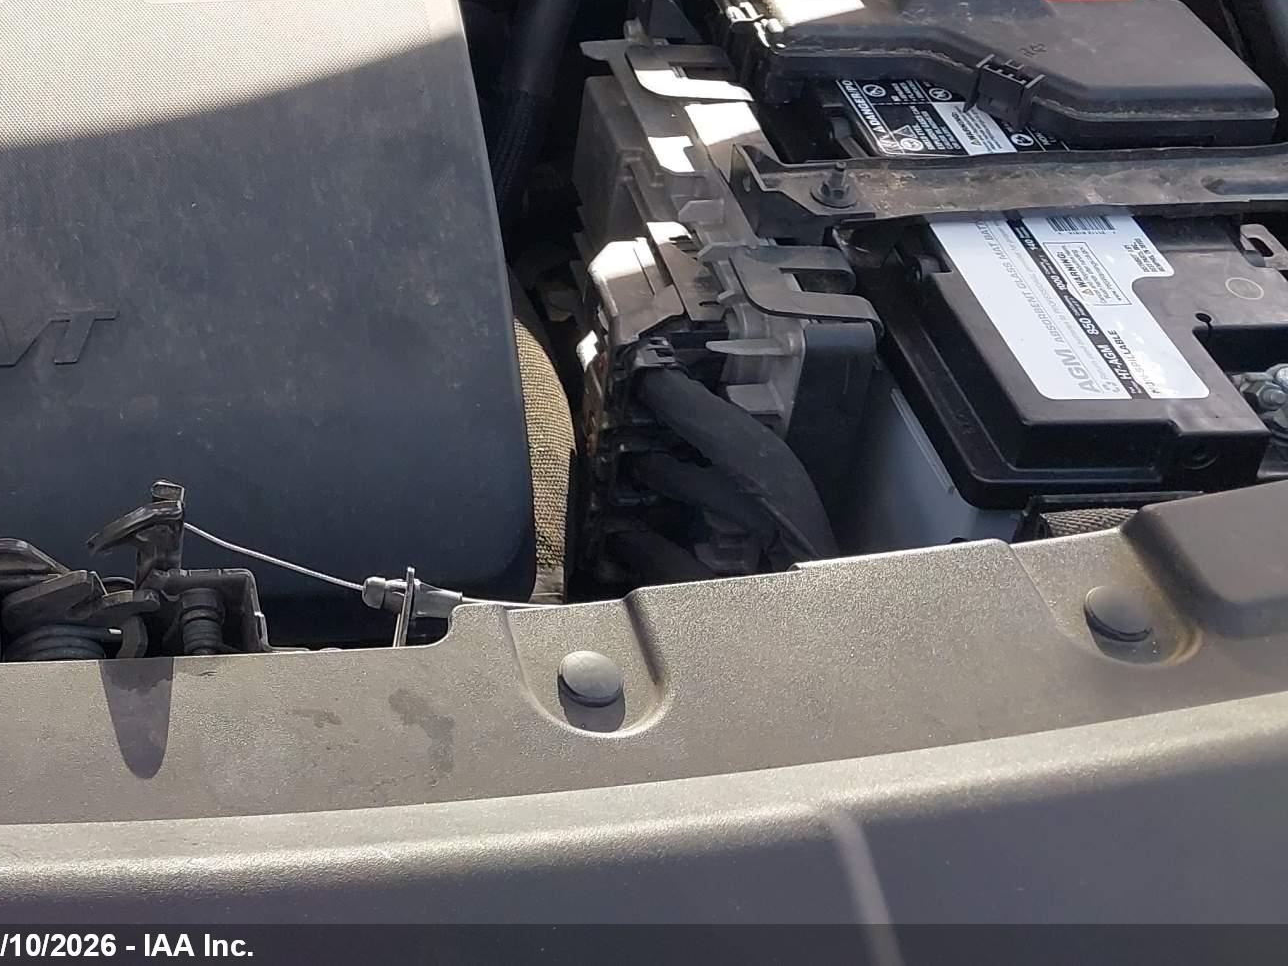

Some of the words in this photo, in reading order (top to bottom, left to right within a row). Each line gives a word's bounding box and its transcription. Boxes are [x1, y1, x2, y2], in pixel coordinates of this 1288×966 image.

[1003, 261, 1026, 290] GLASS
[1022, 290, 1065, 343] ABSORBENT
[1078, 317, 1100, 336] 850
[1054, 348, 1102, 394] AGM
[1096, 344, 1132, 381] H7-AGM
